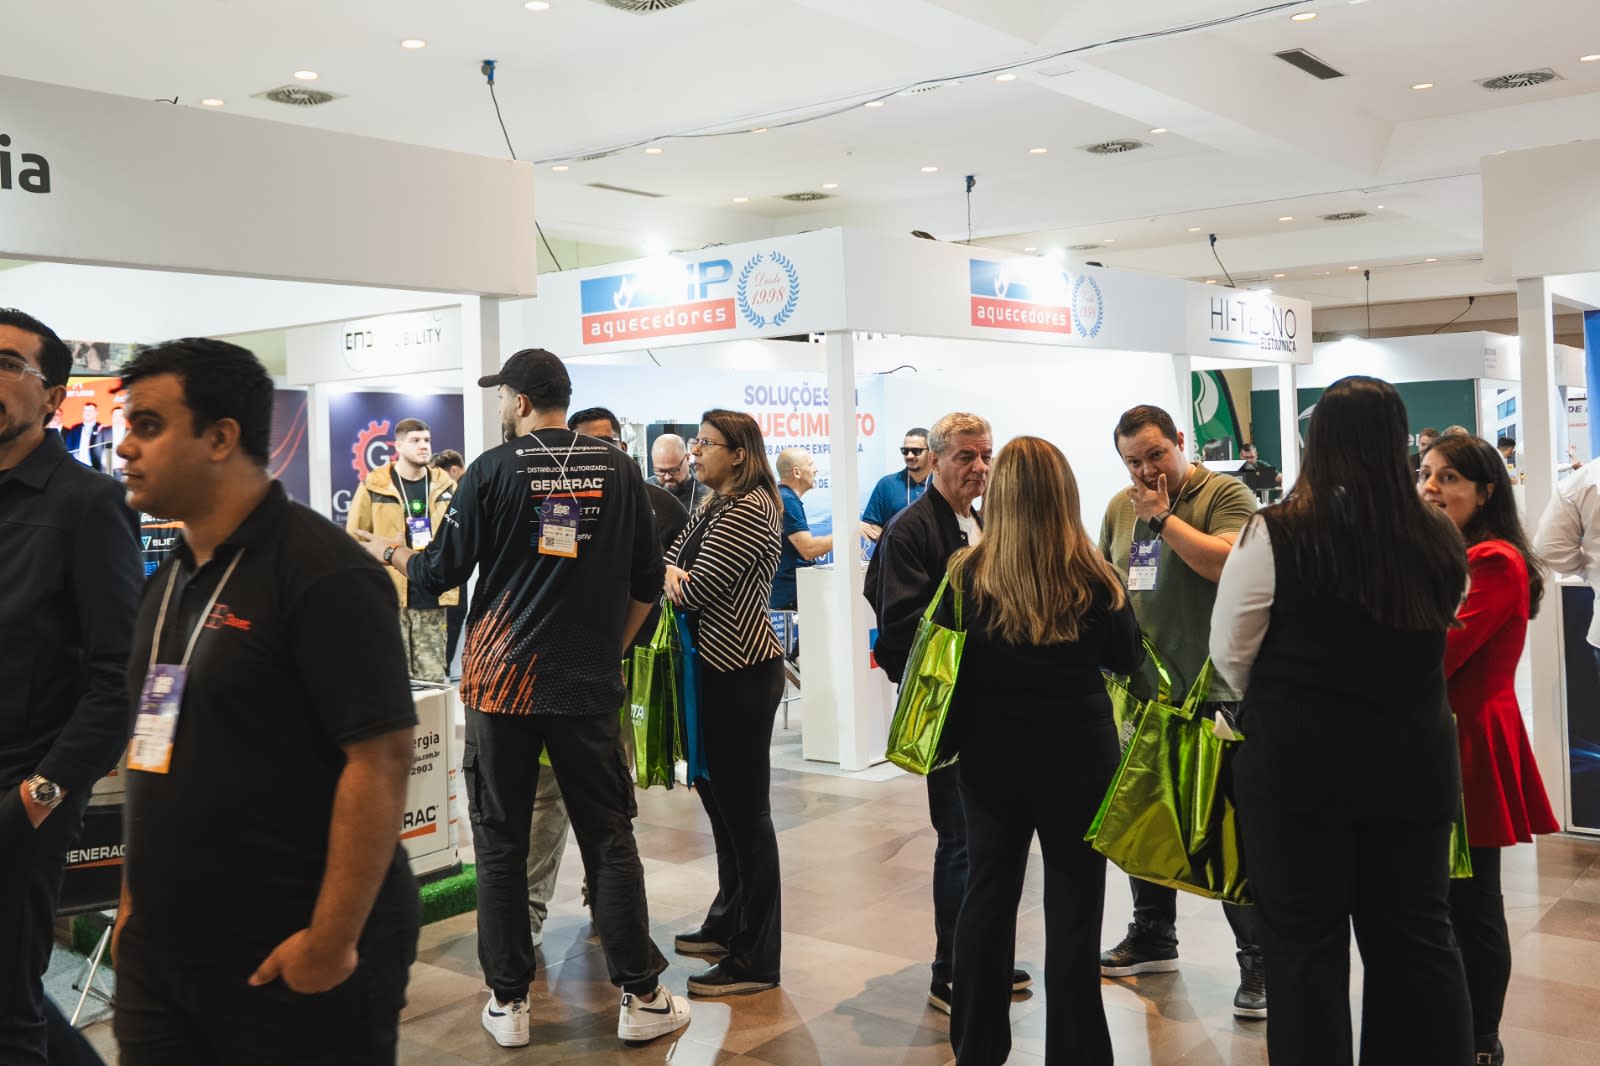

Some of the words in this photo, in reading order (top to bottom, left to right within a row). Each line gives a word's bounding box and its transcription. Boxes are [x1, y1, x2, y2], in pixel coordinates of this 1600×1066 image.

[754, 272, 781, 288] Desde
[751, 287, 785, 306] 1998
[591, 307, 727, 338] aquecedores
[977, 305, 1067, 328] aquecedores
[744, 381, 829, 411] SOLUÇÕES
[570, 465, 608, 473] AUTORIZADO
[530, 477, 604, 491] GENERAC
[65, 844, 127, 863] ENERAC
